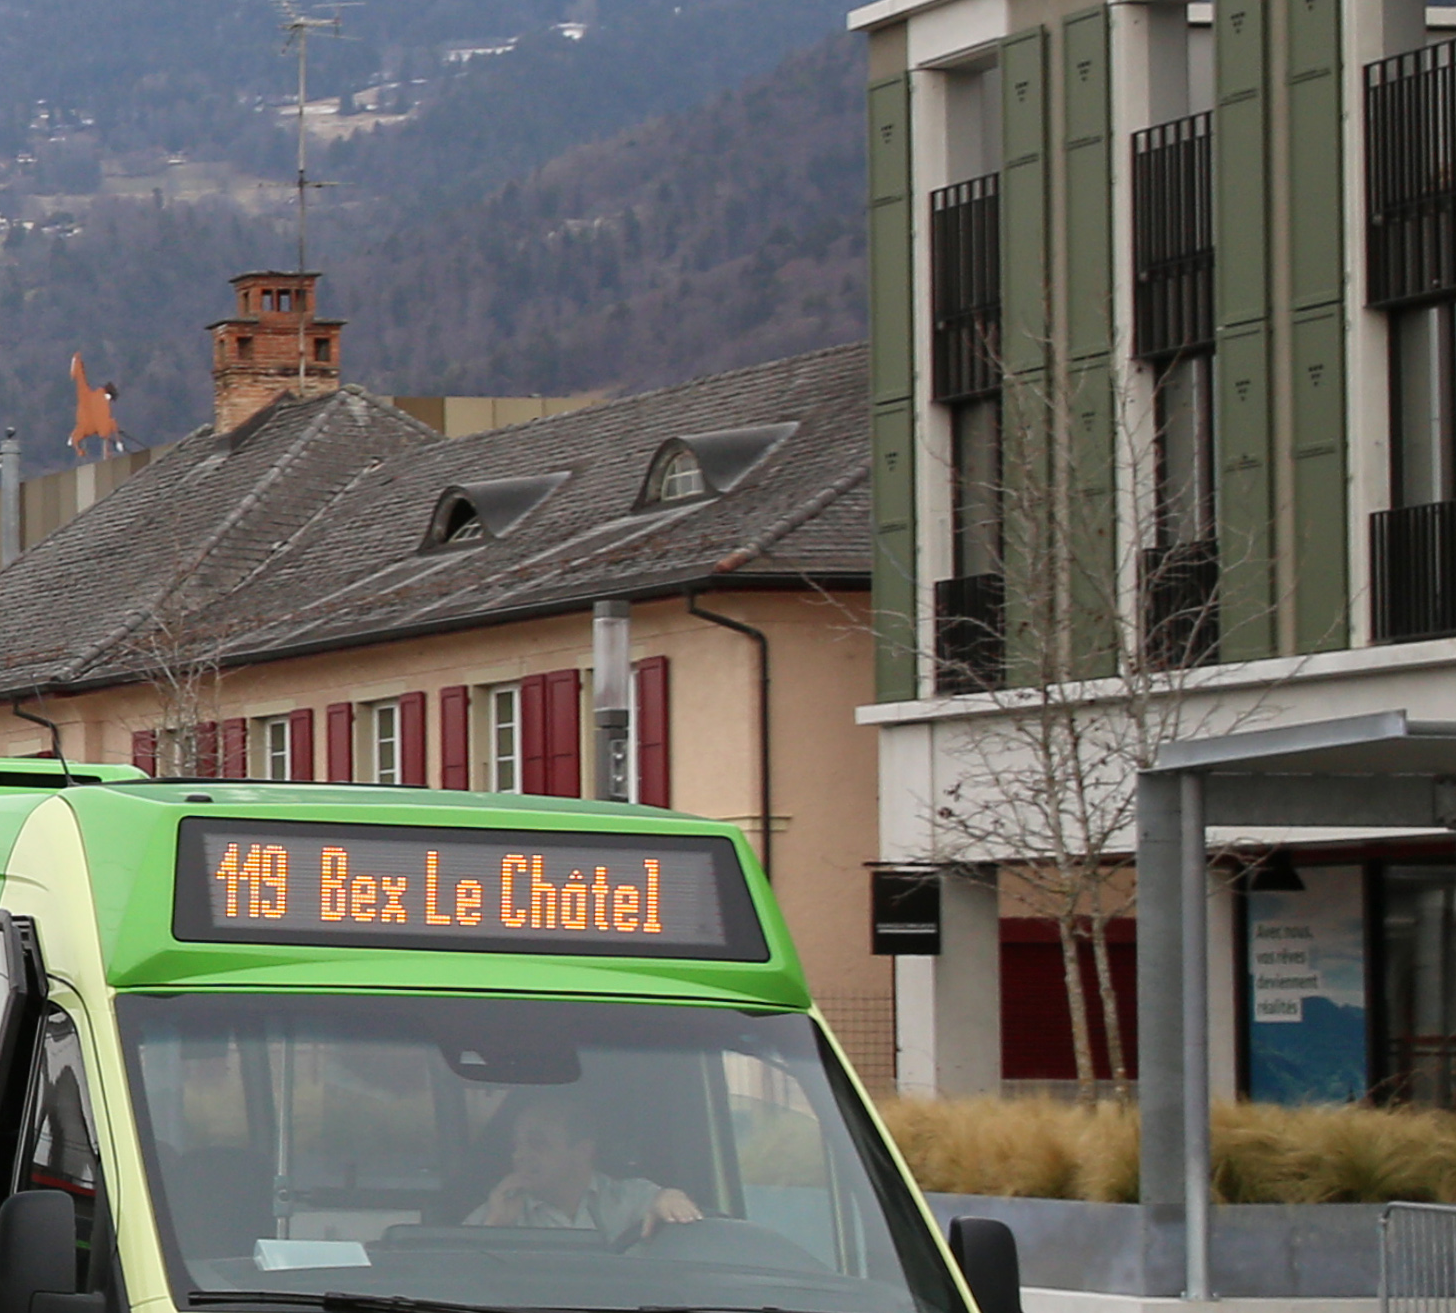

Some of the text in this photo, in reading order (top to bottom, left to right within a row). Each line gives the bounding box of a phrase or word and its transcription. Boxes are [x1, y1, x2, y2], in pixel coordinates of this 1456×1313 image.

[215, 842, 662, 933] 119 Bex Le Châtel
